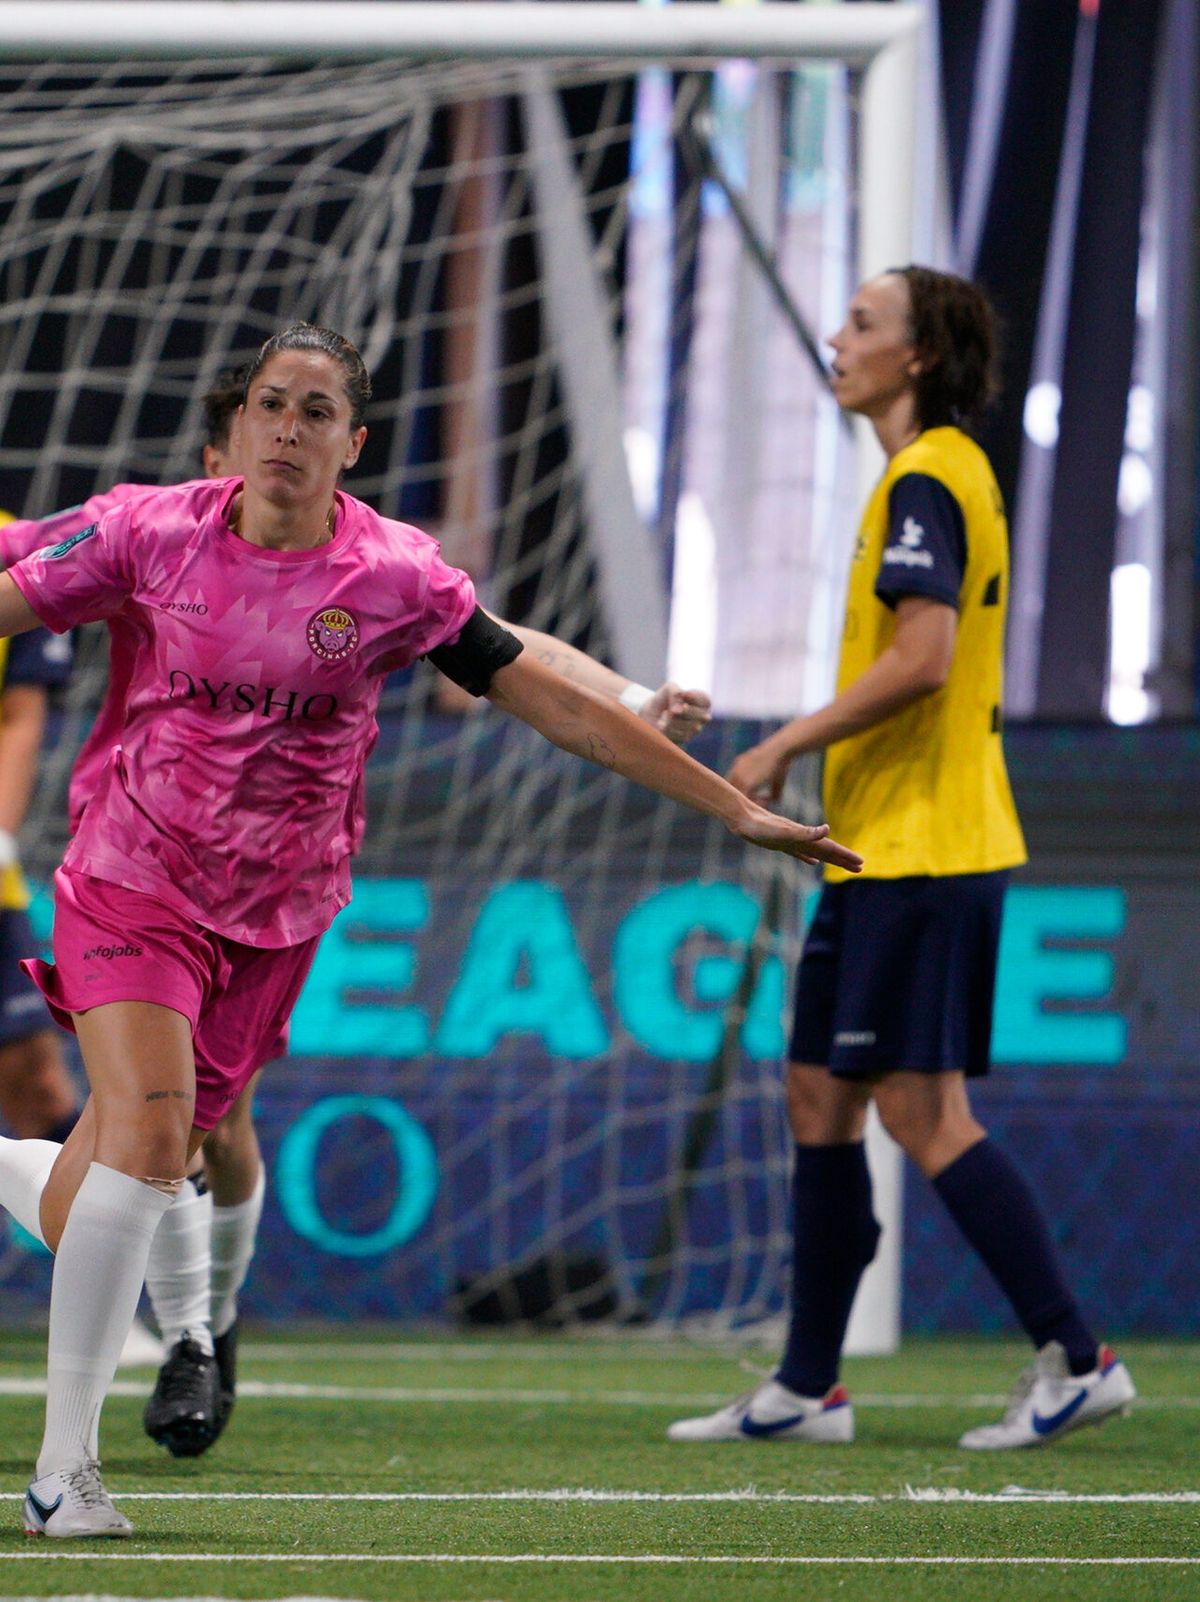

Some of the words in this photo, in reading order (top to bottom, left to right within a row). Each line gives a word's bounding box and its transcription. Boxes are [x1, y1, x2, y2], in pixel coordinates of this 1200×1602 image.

[159, 601, 209, 616] OYSHO
[169, 669, 339, 722] OYSHO
[83, 943, 143, 960] infojobs
[286, 876, 1128, 1066] EAGE
